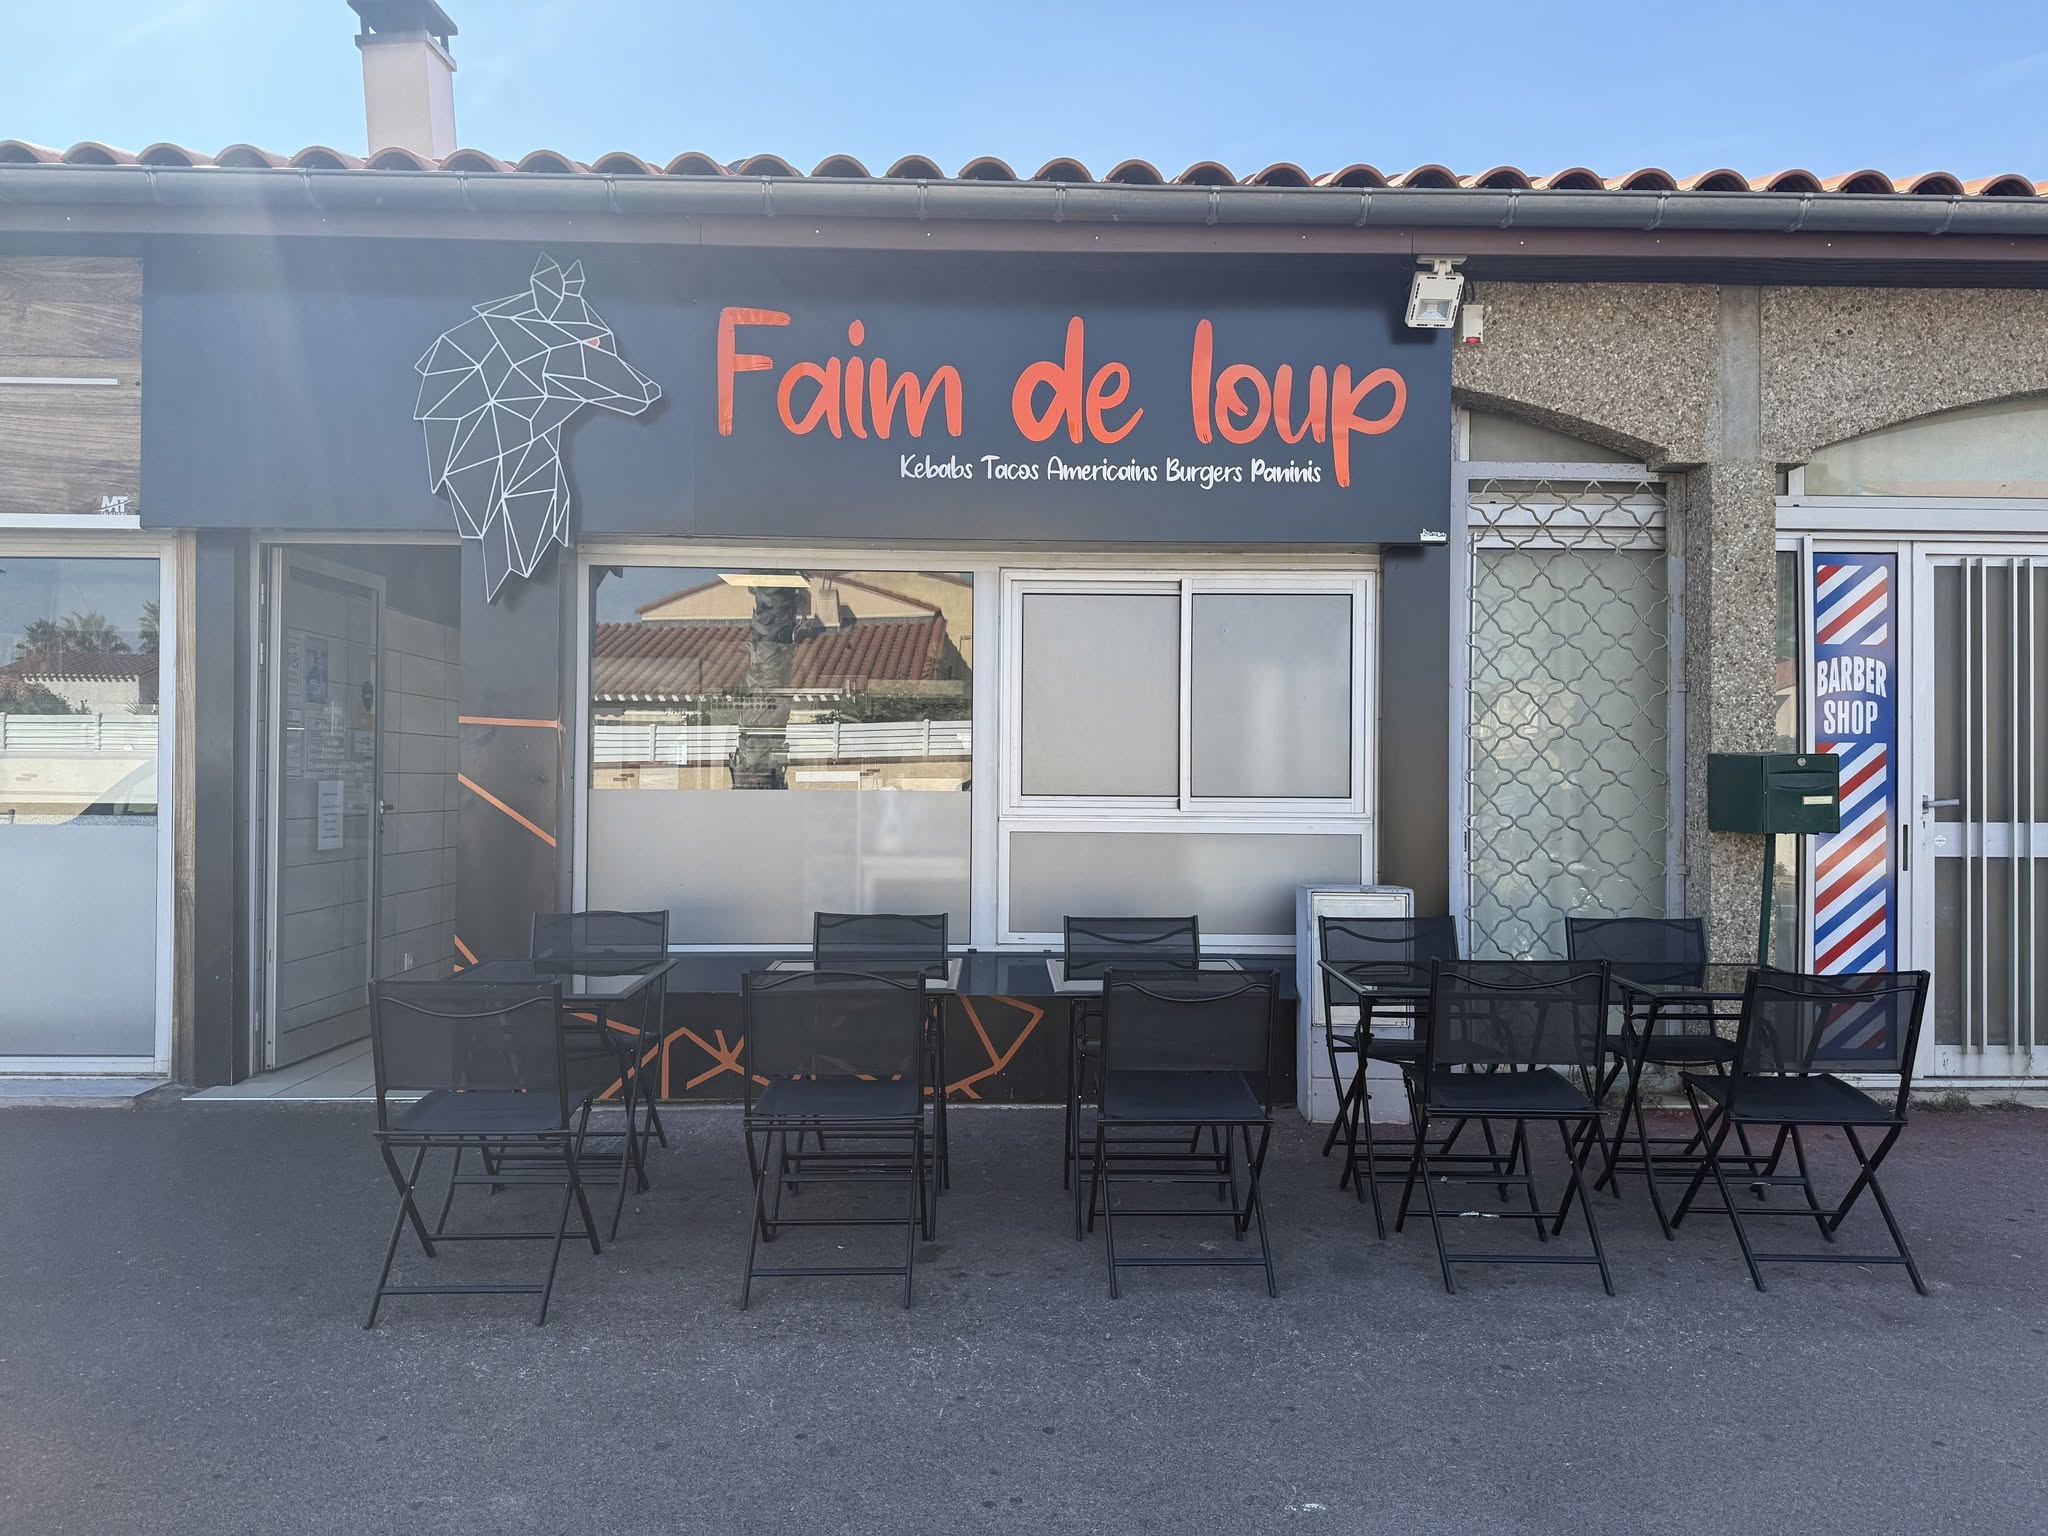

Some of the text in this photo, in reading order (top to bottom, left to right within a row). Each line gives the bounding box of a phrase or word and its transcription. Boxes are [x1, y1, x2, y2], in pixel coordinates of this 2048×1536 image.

[717, 306, 1408, 489] Faim de loup
[900, 453, 1322, 490] Kebabs Tacos Americains Burgers Paninis
[1816, 655, 1887, 698] BARBER
[1823, 699, 1878, 735] SHOP
